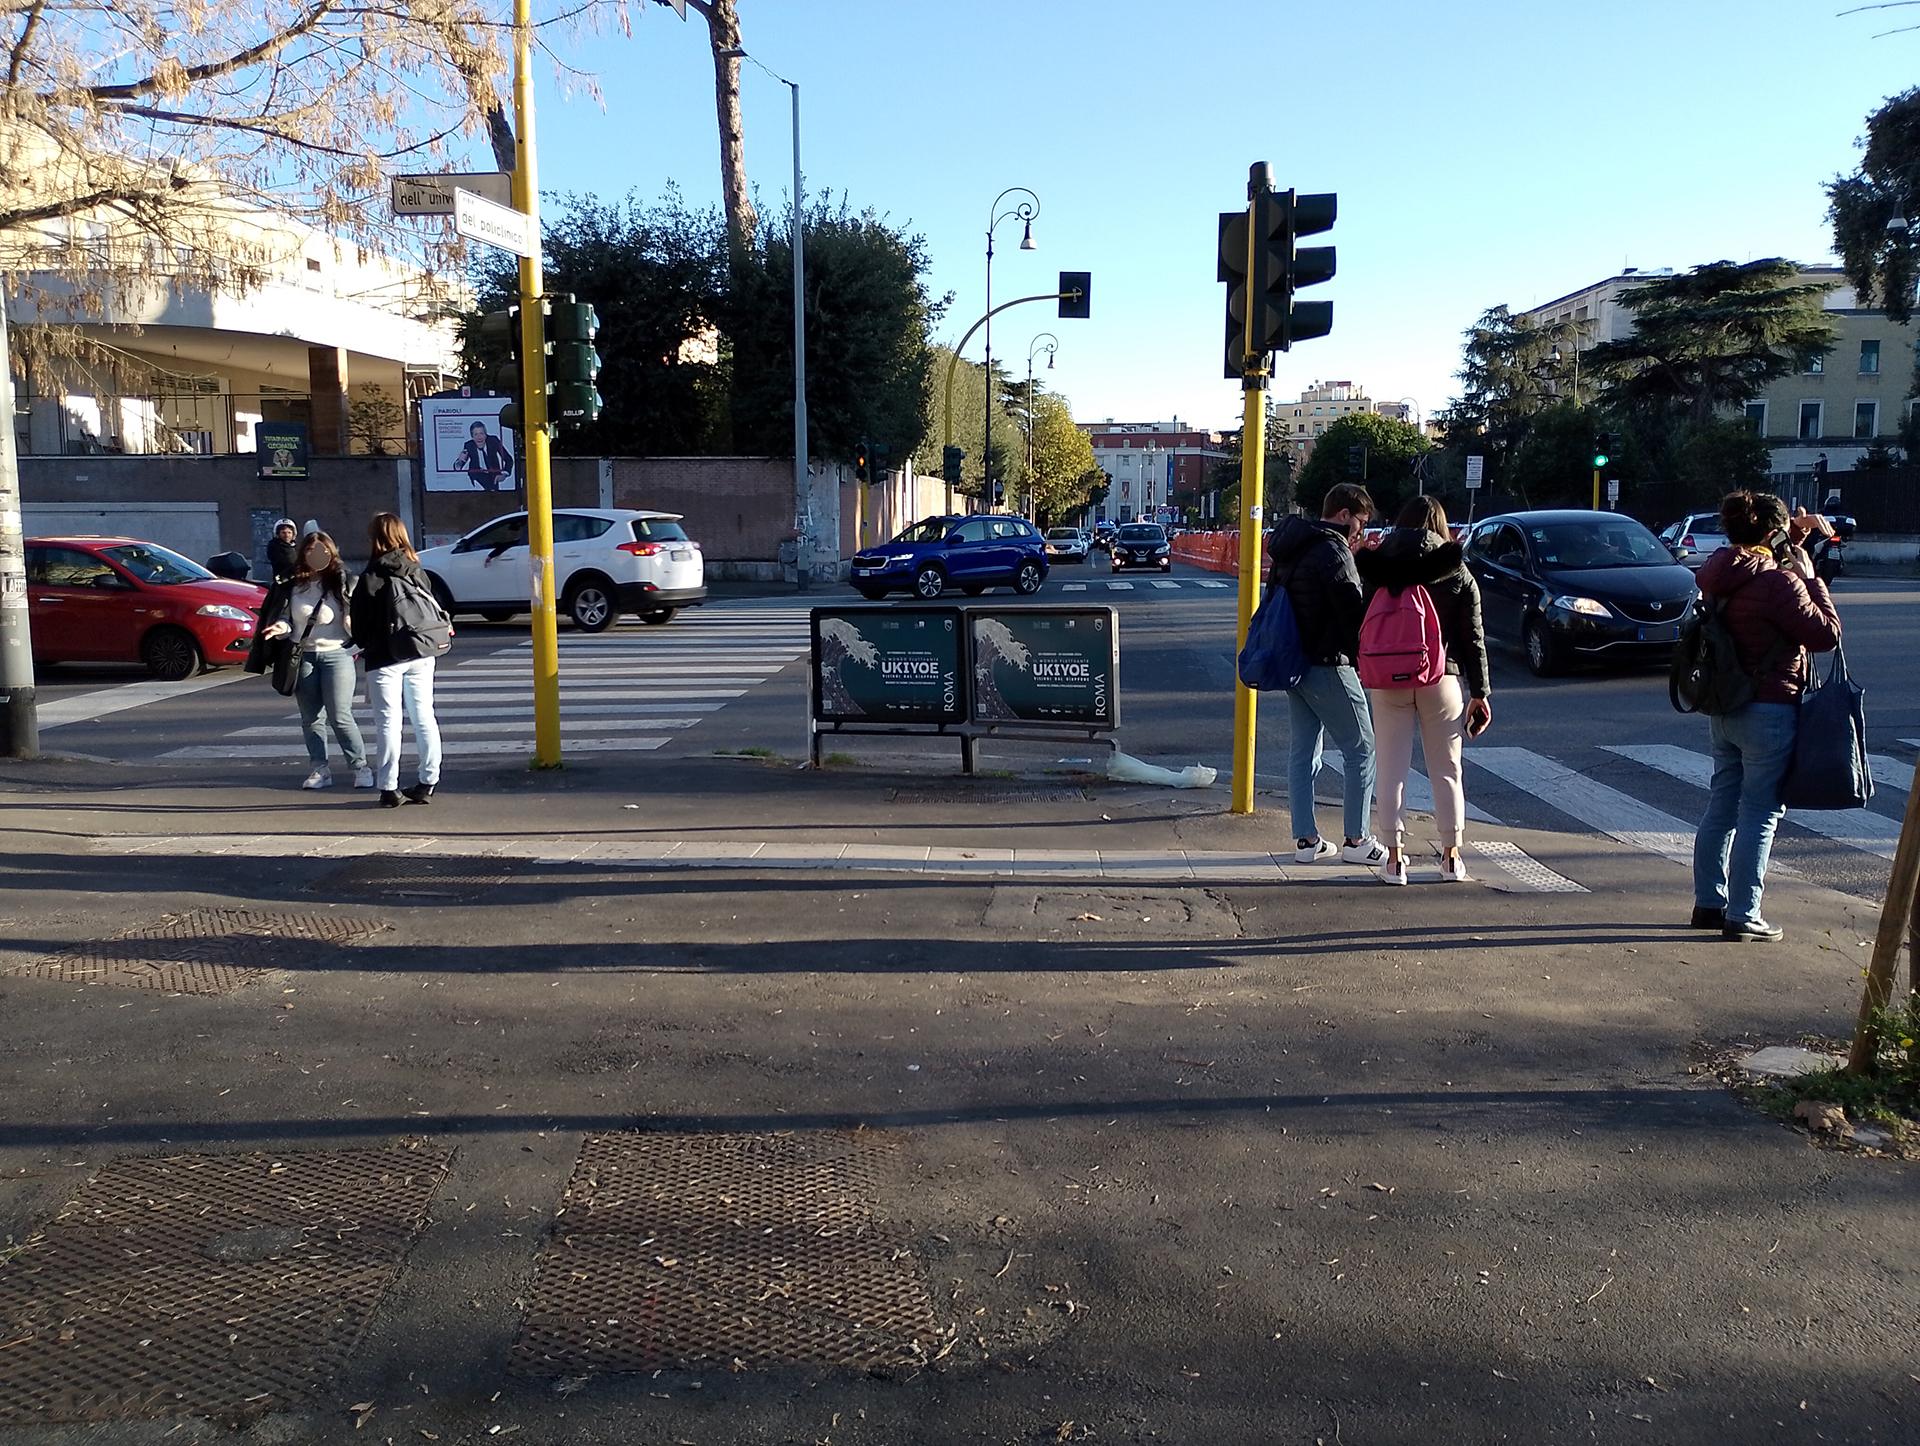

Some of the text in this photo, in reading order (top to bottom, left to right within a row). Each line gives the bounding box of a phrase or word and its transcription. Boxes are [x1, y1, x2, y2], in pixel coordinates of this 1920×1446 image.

[462, 212, 476, 227] del
[881, 661, 939, 674] UKIYOE
[1032, 663, 1090, 676] UKIYOE
[943, 671, 954, 711] ROMA
[1094, 673, 1106, 716] ROMA
